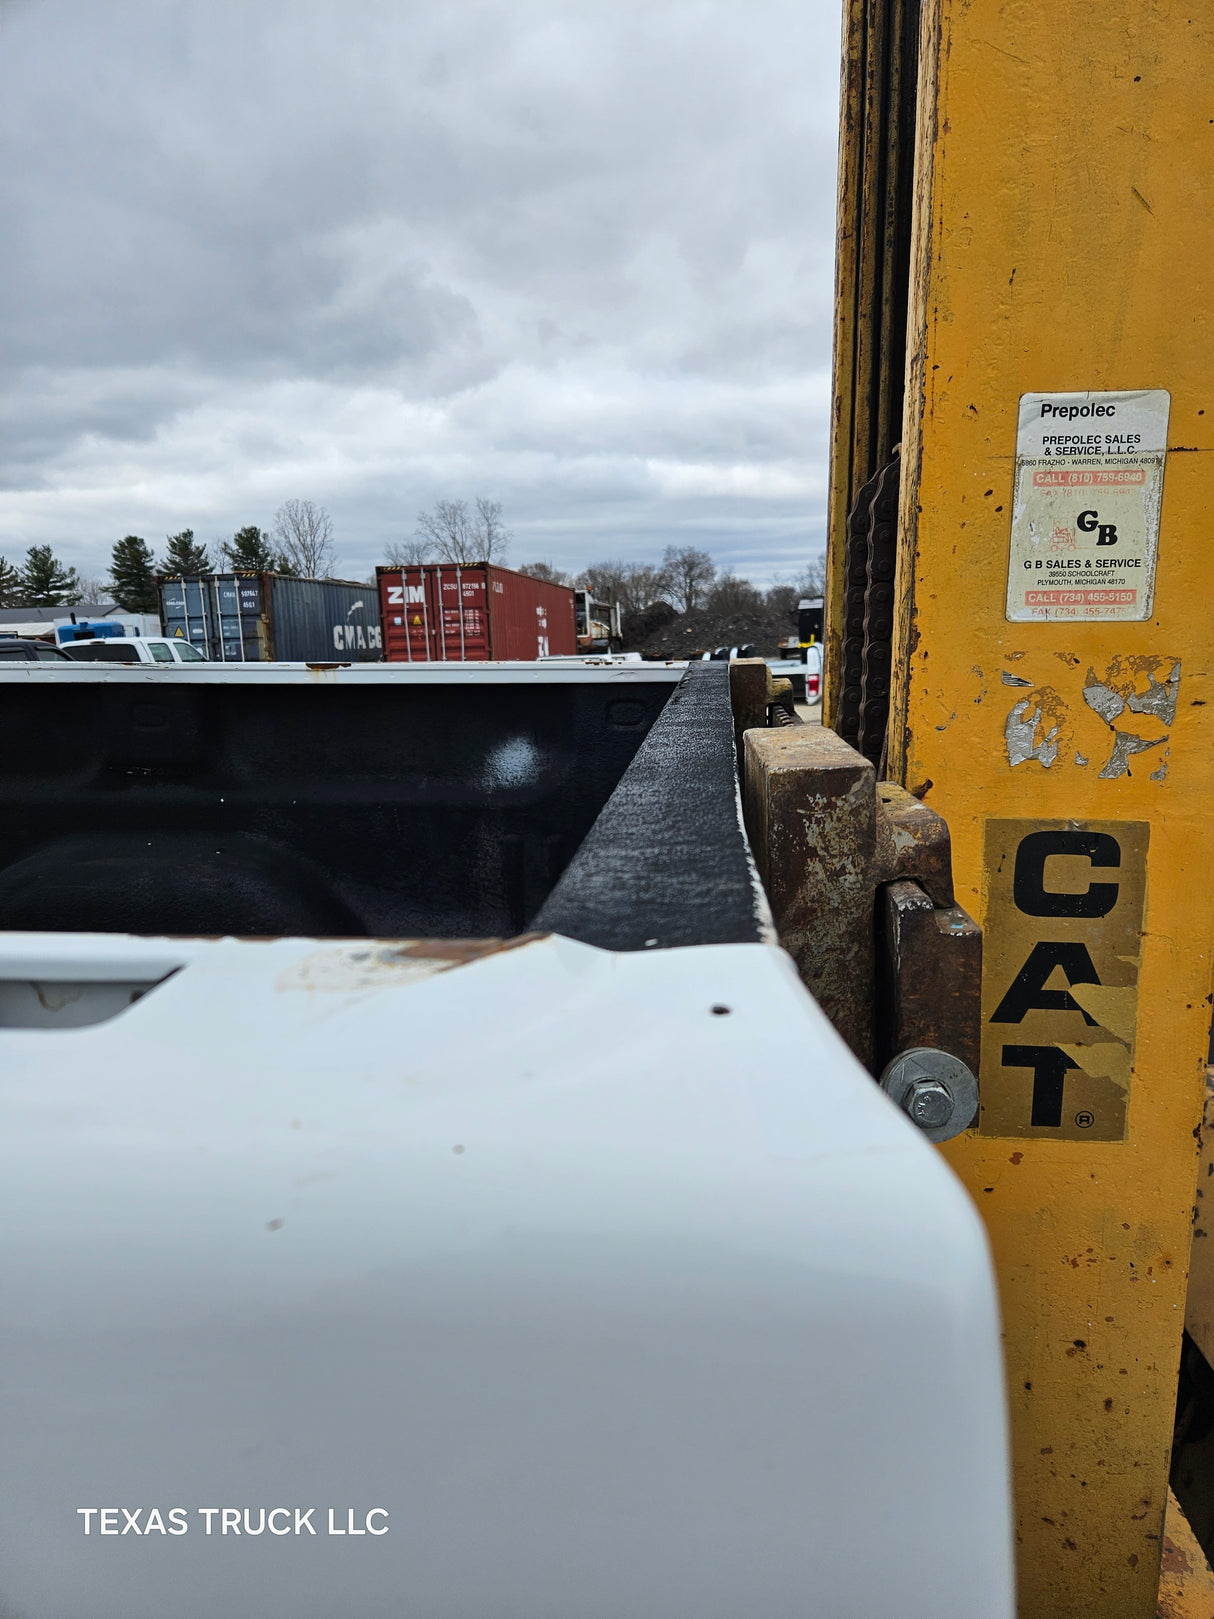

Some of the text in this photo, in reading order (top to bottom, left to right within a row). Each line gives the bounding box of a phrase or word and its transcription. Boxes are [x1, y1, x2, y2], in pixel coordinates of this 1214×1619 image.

[1041, 403, 1115, 421] Prepolec
[1043, 434, 1141, 445] PREPOLEC SALES
[1044, 447, 1052, 456] &
[1055, 446, 1105, 456] SERVICE,
[1036, 473, 1065, 483] CALL
[1068, 473, 1094, 484] (810)
[1024, 559, 1141, 569] G B SALES & SERVICE
[387, 586, 424, 604] ZIM
[1028, 592, 1133, 604] CALL (734) 455-5150
[333, 625, 367, 650] CMA
[989, 831, 1121, 1127] CAT
